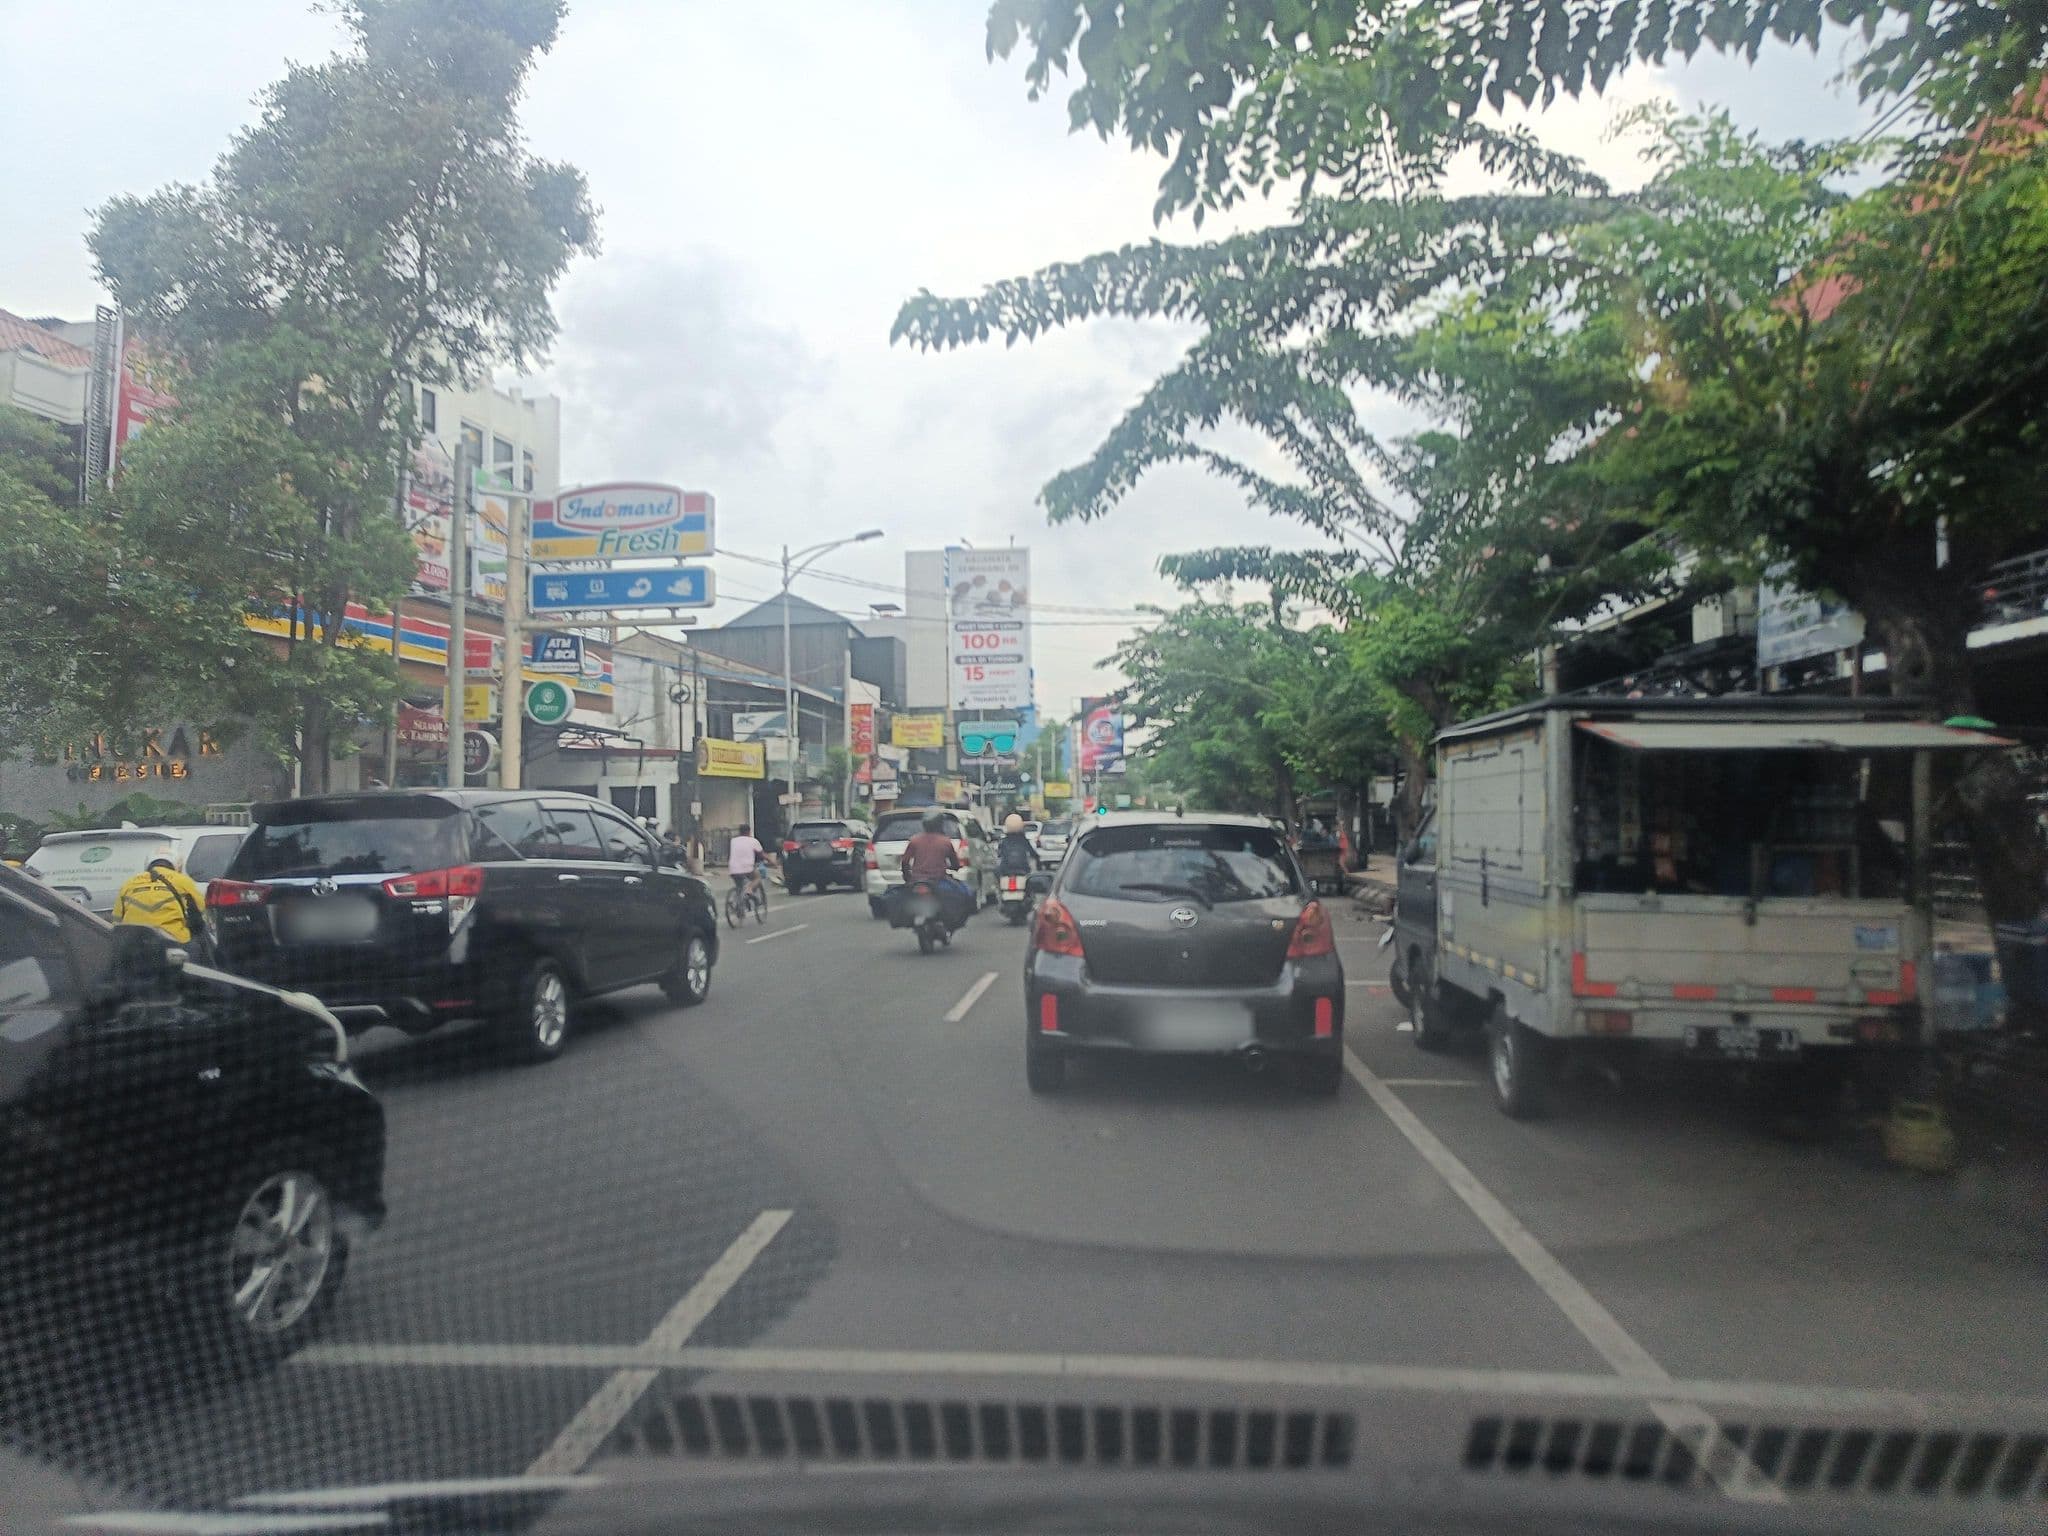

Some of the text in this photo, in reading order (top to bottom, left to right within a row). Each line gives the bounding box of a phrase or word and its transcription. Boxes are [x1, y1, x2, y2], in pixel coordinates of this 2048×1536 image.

[563, 496, 673, 520] Indomaret
[598, 526, 680, 554] Fresh
[547, 638, 572, 649] ATM
[962, 633, 1000, 649] 100
[963, 666, 984, 681] 15
